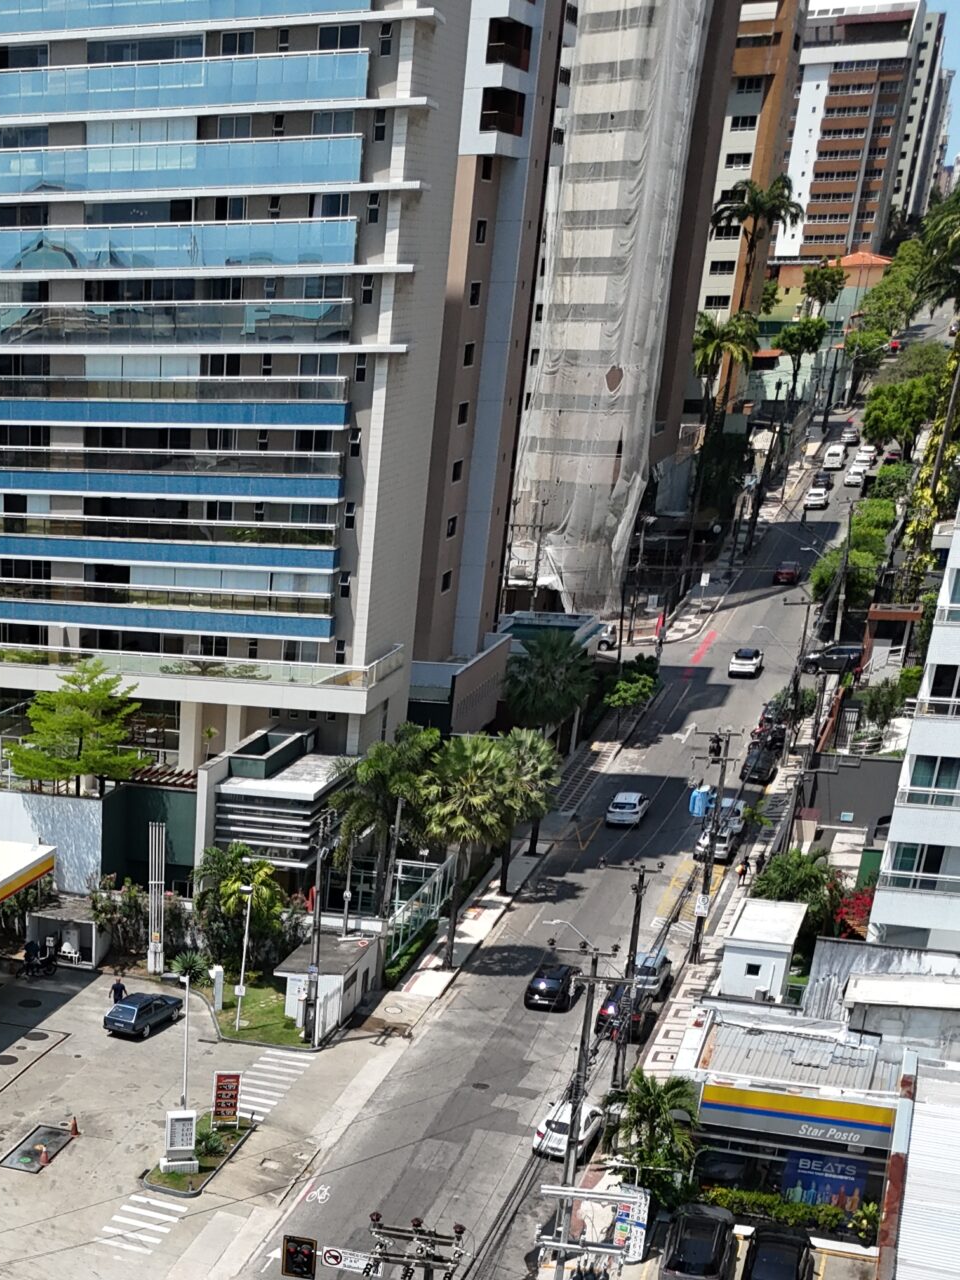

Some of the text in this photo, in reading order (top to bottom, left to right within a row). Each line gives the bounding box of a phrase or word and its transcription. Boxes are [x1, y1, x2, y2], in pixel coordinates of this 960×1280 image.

[798, 1124, 860, 1142] Star Posto
[798, 1158, 857, 1176] BEATS
